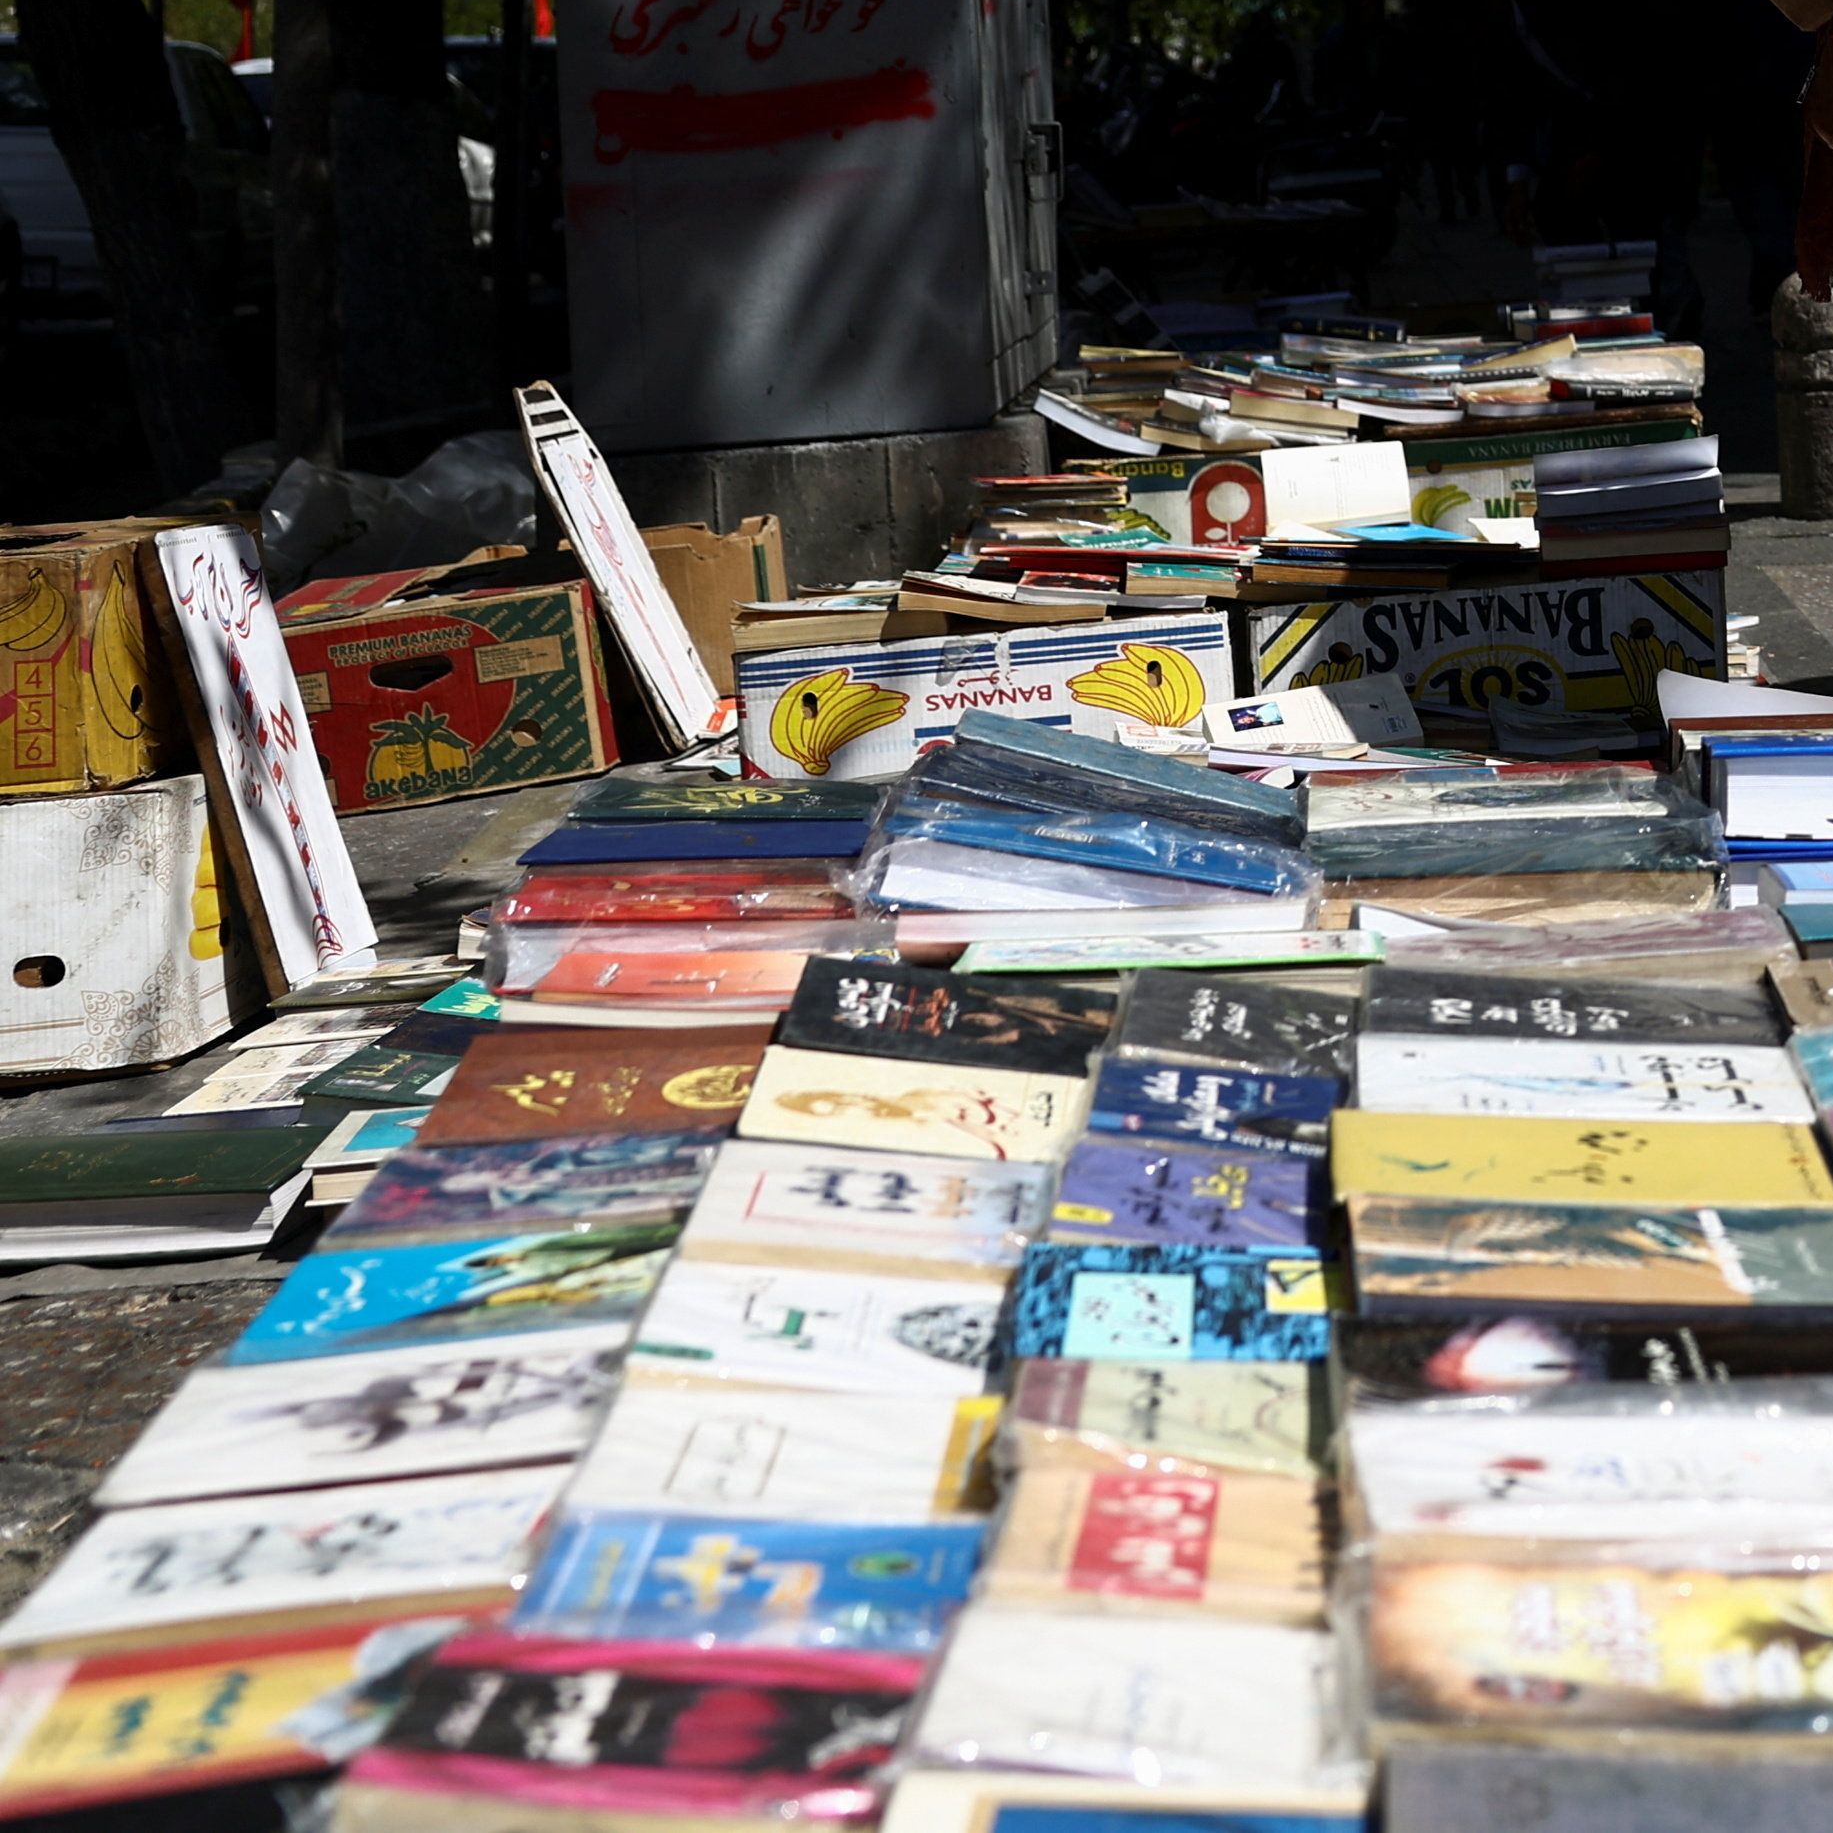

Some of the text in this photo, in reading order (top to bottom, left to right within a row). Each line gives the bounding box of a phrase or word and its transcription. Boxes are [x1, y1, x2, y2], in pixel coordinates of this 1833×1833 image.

[1467, 440, 1531, 460] BANANA
[327, 625, 474, 659] PREMIUM BANANAS
[1363, 586, 1611, 674] BANANAS
[25, 665, 43, 689] 4
[1429, 661, 1553, 710] SOL
[925, 684, 1053, 712] BANANAS
[25, 700, 42, 726] 5
[25, 736, 42, 762] 6
